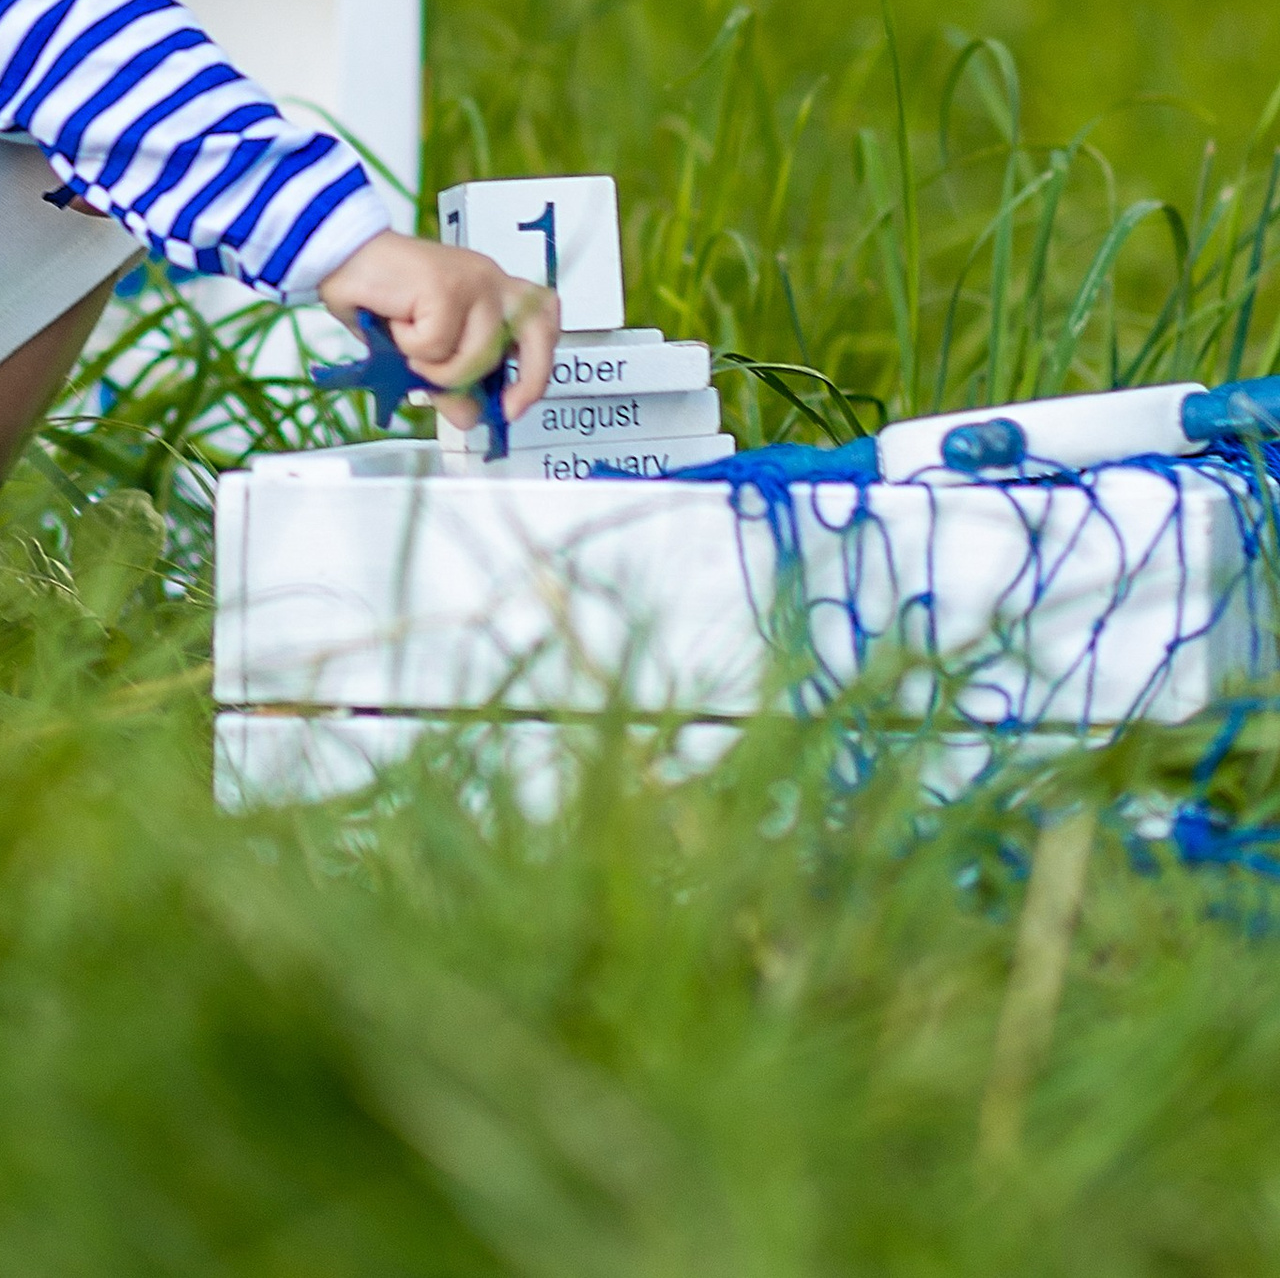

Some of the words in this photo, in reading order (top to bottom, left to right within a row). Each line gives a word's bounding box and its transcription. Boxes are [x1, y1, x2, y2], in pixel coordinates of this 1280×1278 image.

[517, 201, 557, 290] 1
[542, 398, 641, 436] august
[542, 452, 670, 480] febary
